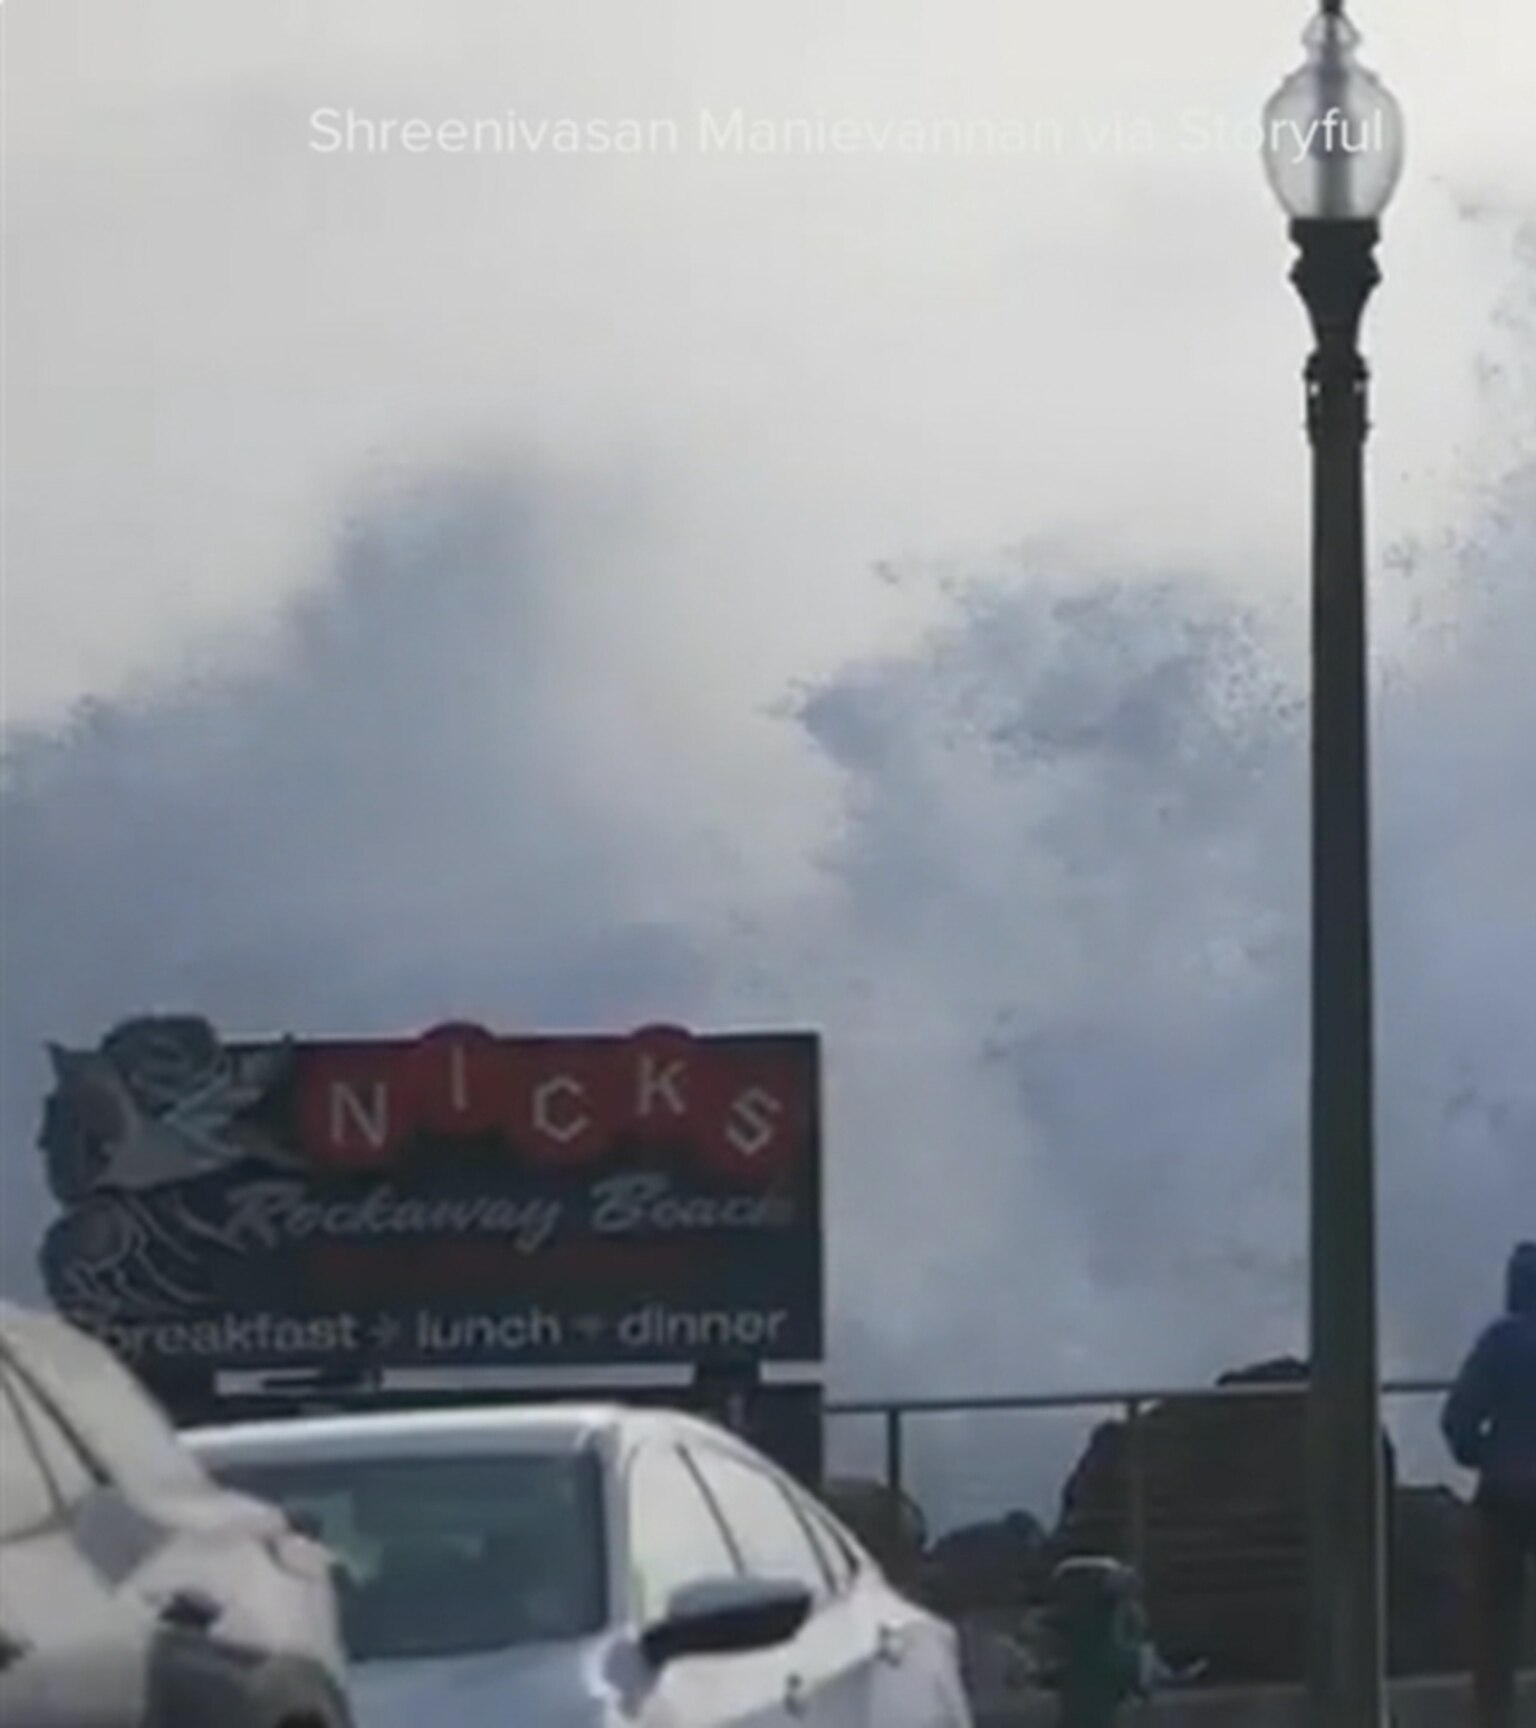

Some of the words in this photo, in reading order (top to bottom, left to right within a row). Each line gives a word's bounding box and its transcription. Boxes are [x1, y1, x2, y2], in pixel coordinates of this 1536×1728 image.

[329, 1044, 783, 1157] NICKS
[223, 1180, 562, 1252] Rockaway
[417, 1307, 562, 1350] lunch
[616, 1303, 788, 1347] dinner
